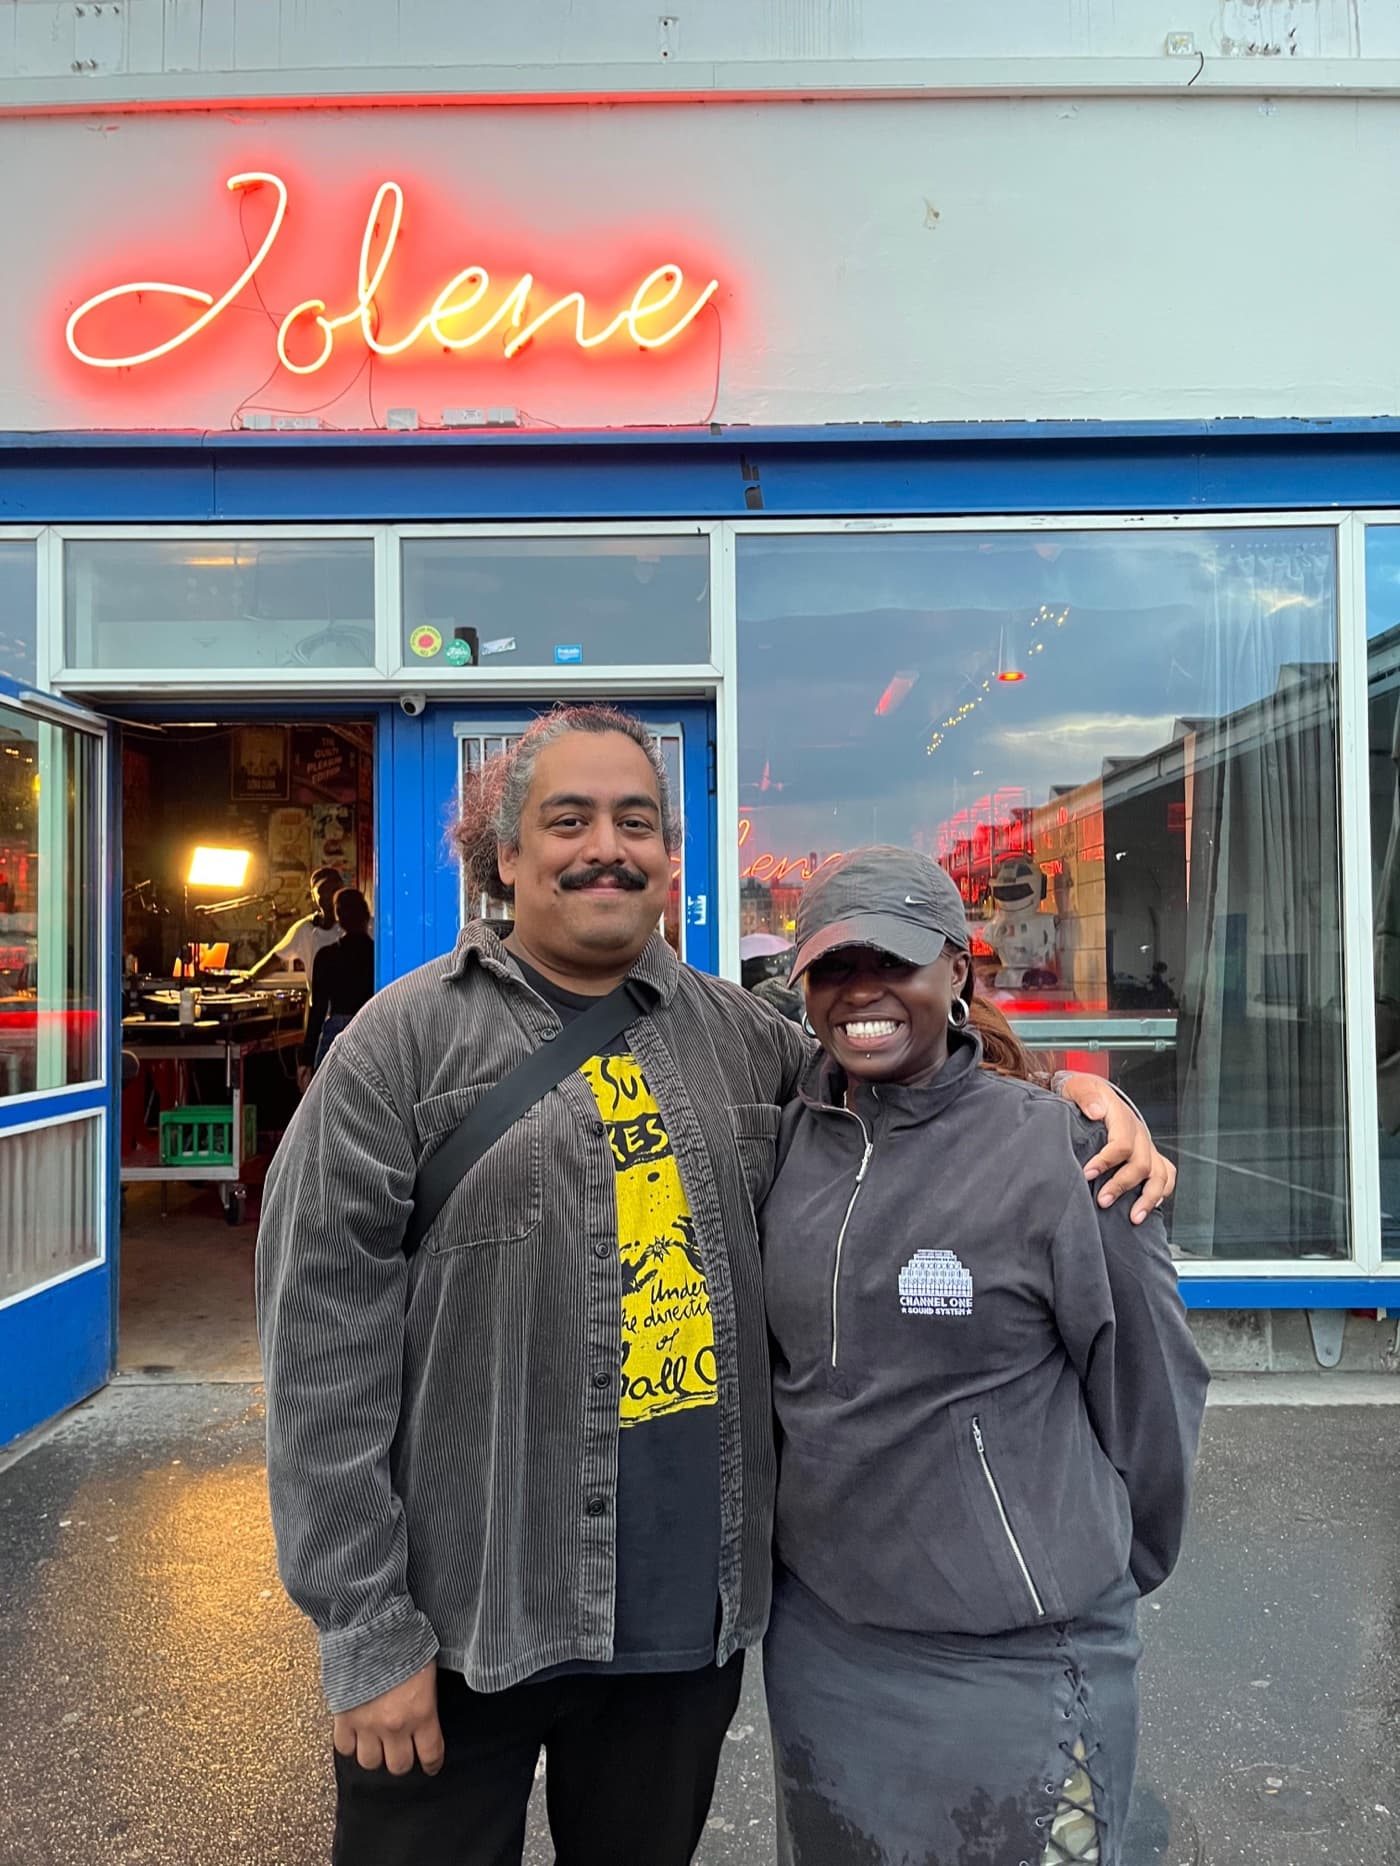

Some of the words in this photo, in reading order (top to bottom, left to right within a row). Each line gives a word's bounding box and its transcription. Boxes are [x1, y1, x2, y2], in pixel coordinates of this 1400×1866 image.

[65, 172, 719, 374] Jolene
[651, 1274, 710, 1305] Under
[899, 1296, 947, 1307] CHANNEL
[949, 1297, 973, 1308] ONE
[907, 1307, 935, 1315] SOUND
[935, 1308, 966, 1316] SYSTEM
[656, 1327, 680, 1352] of
